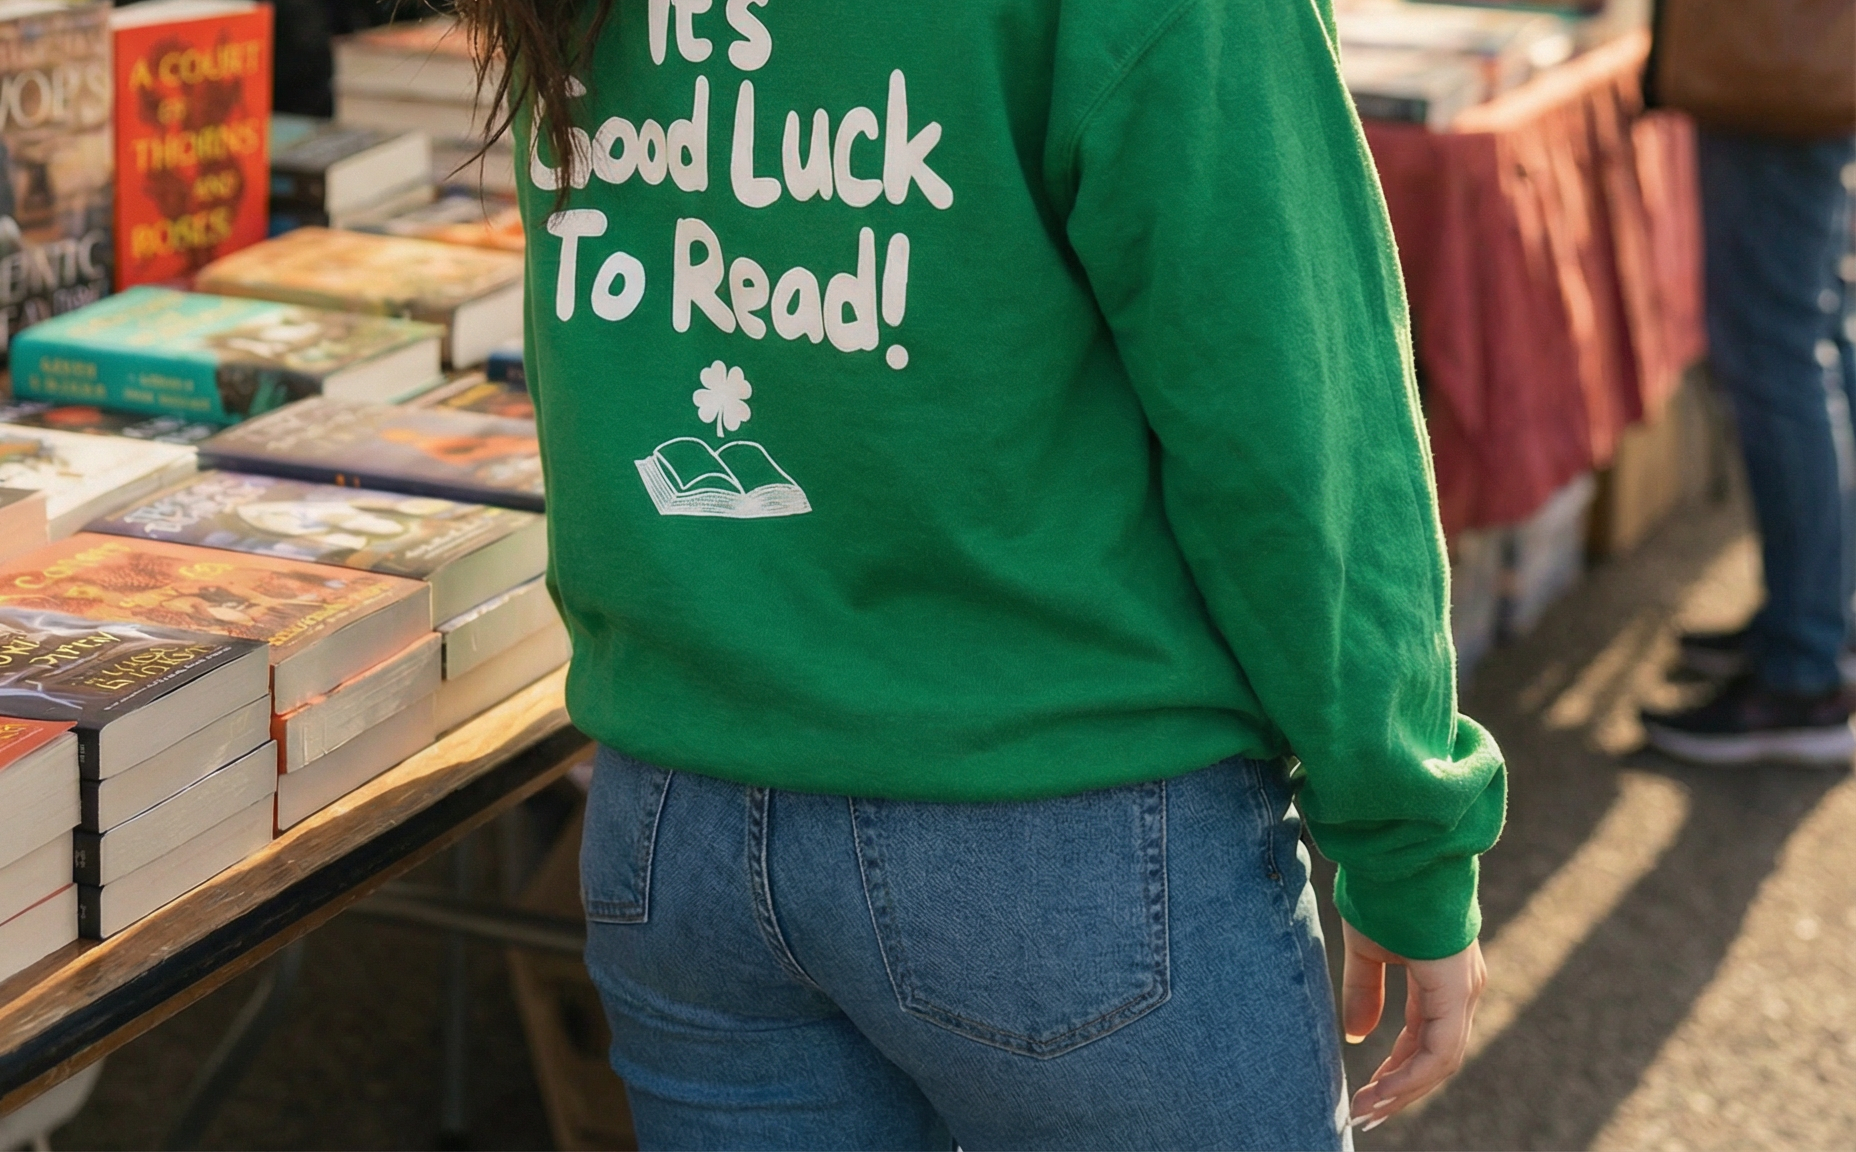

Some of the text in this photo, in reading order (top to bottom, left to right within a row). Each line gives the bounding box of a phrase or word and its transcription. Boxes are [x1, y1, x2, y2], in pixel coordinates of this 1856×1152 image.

[129, 56, 153, 91] A
[730, 68, 954, 210] Luck
[546, 208, 910, 370] To Read!
